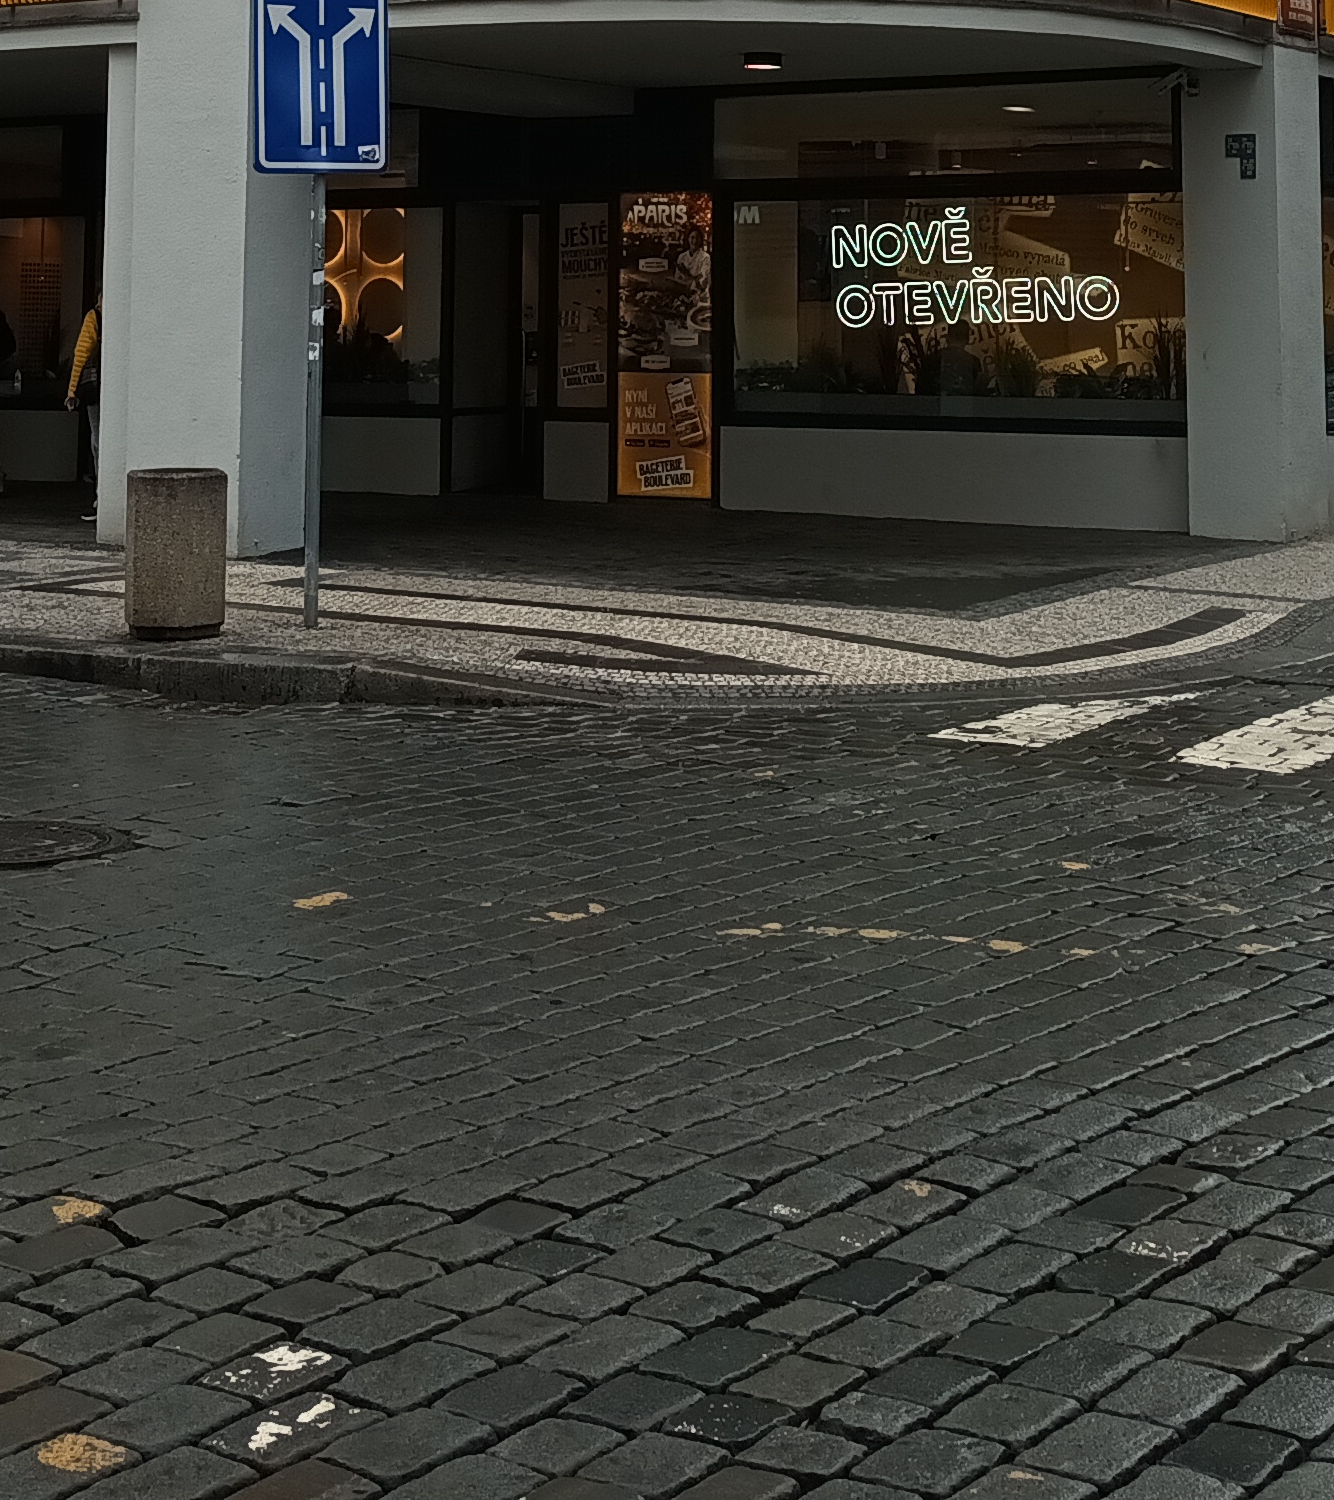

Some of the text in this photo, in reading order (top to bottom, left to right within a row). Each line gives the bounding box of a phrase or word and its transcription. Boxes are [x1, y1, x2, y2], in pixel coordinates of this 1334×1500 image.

[633, 204, 688, 227] PARIS
[831, 207, 972, 269] NOVĚ
[835, 266, 1120, 329] OTEVŘENO
[638, 457, 684, 477] BAGETERIE
[643, 472, 692, 489] BOULEVARD
